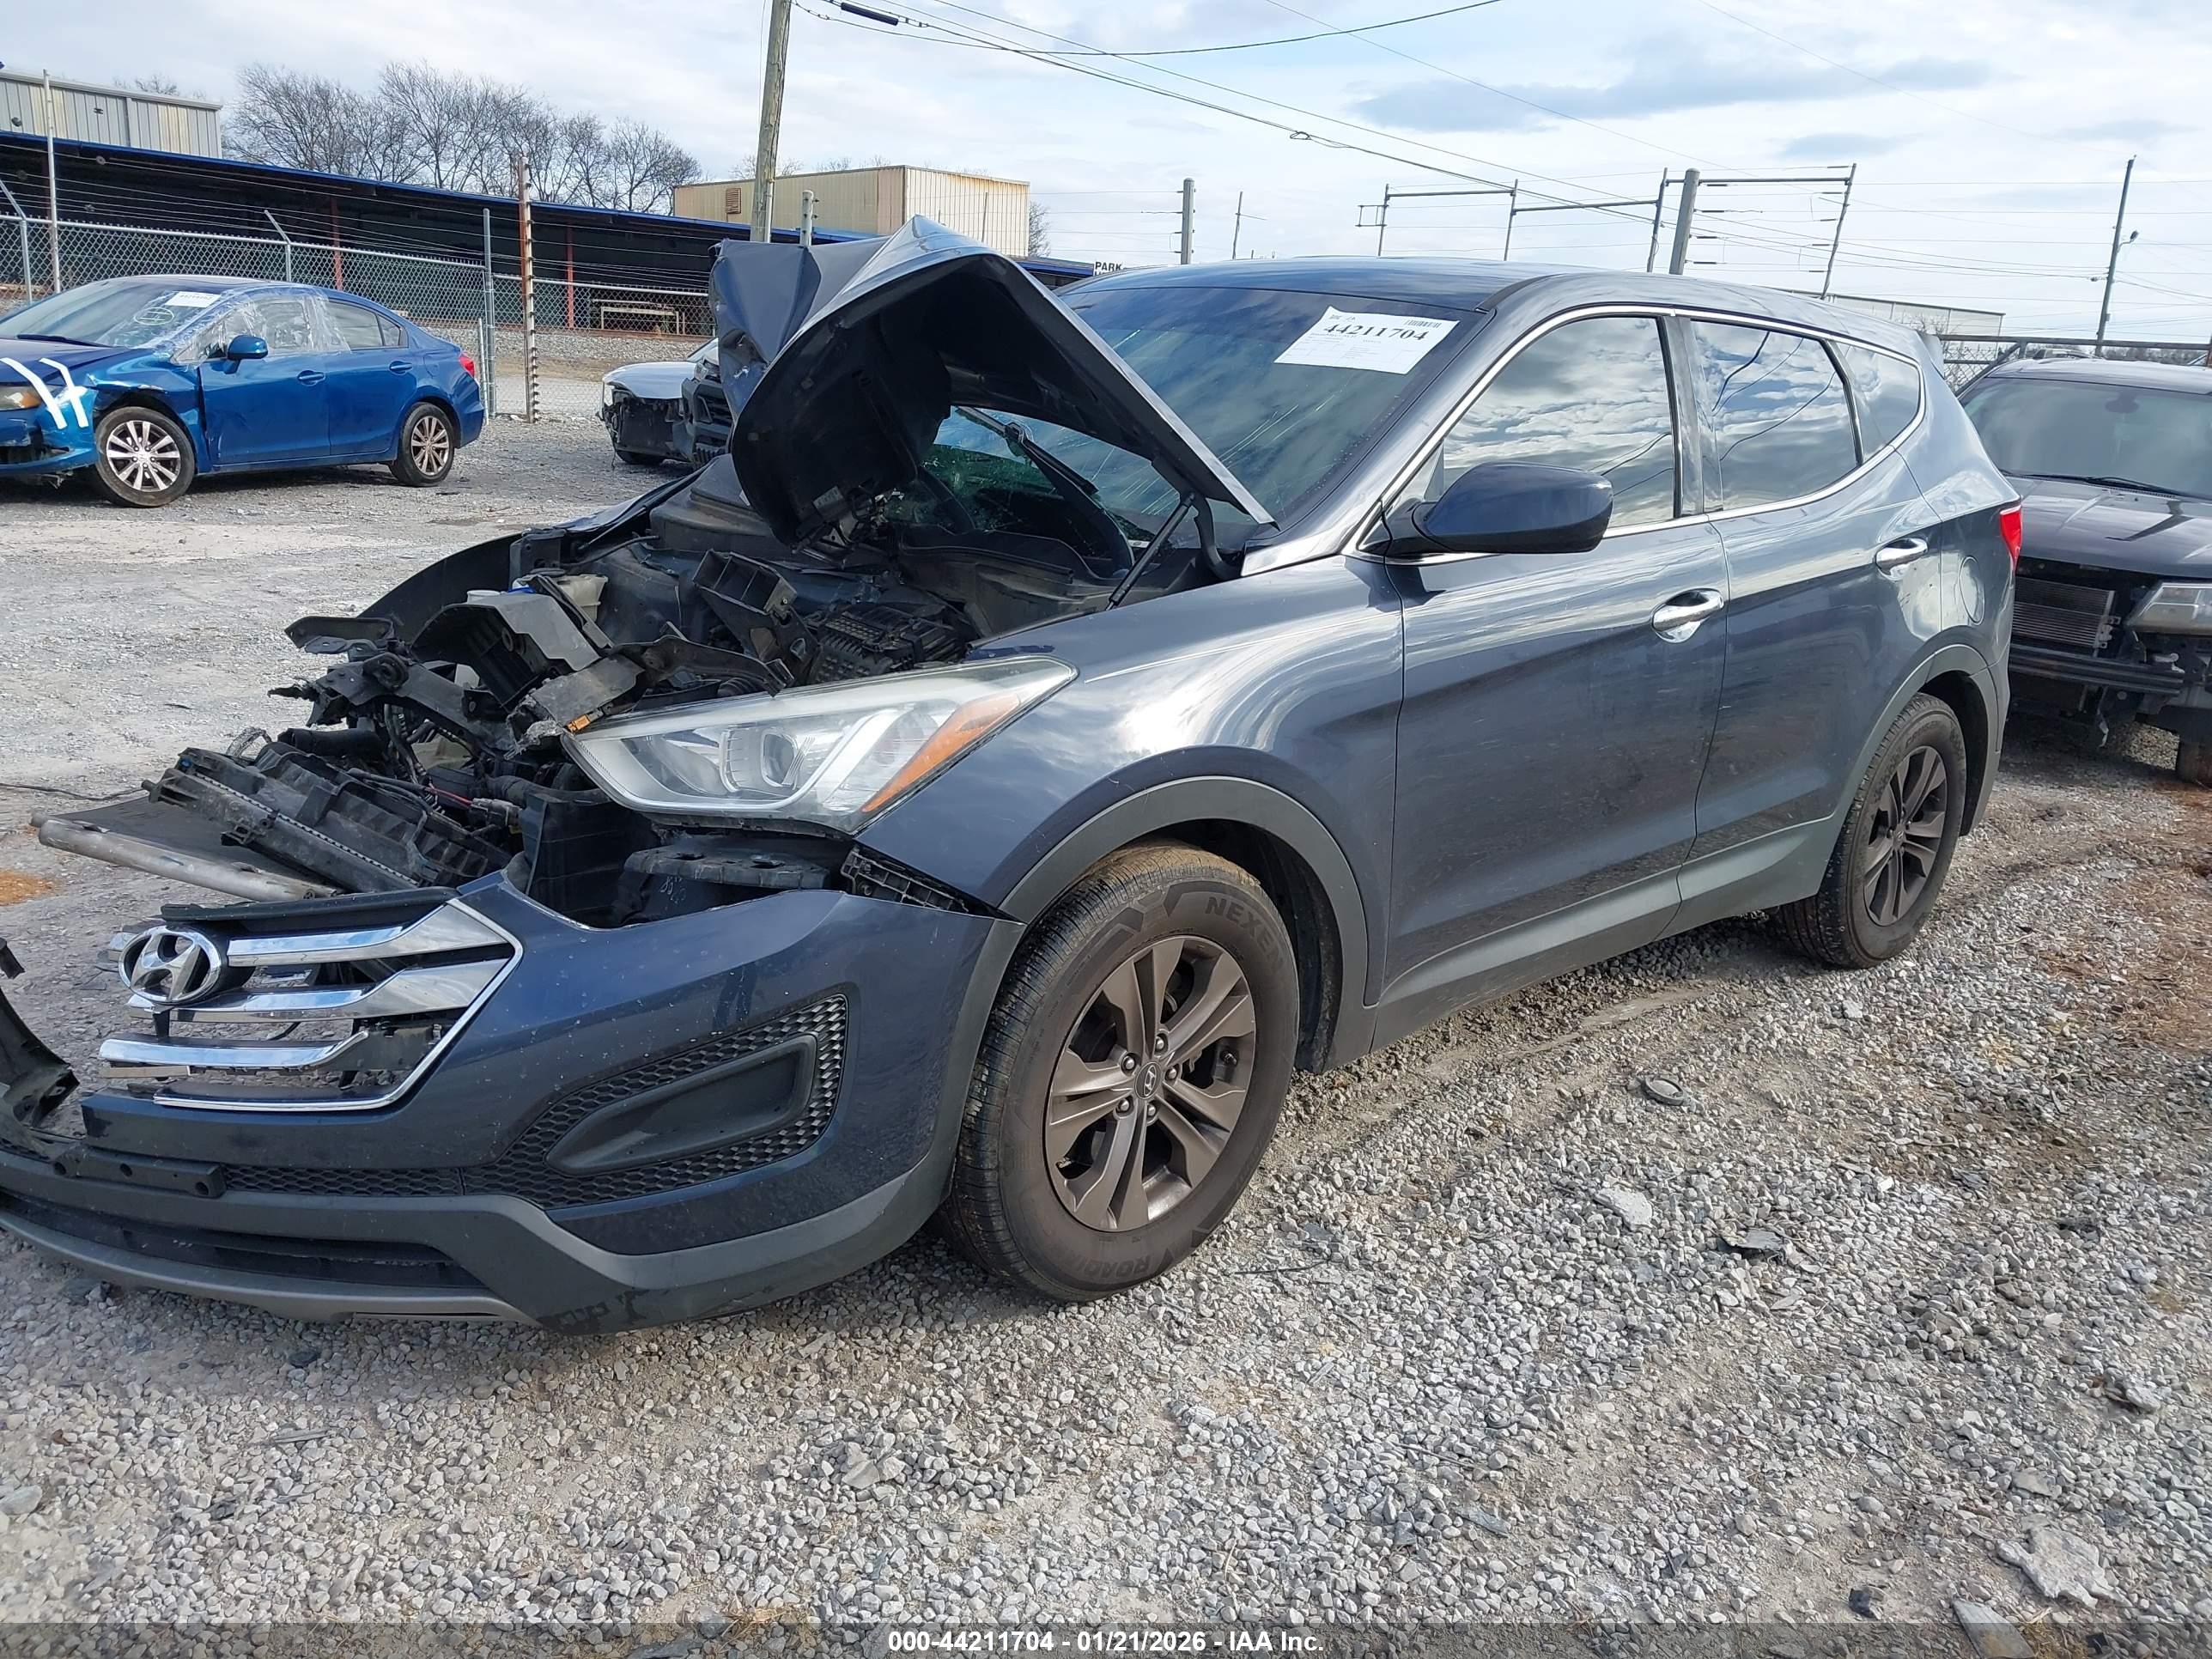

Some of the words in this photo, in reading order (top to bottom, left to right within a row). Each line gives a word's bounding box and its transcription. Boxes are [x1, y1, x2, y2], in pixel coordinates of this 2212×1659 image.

[1095, 261, 1122, 271] PARK
[1323, 324, 1429, 340] 44211704
[1204, 896, 1284, 973] NEXEN
